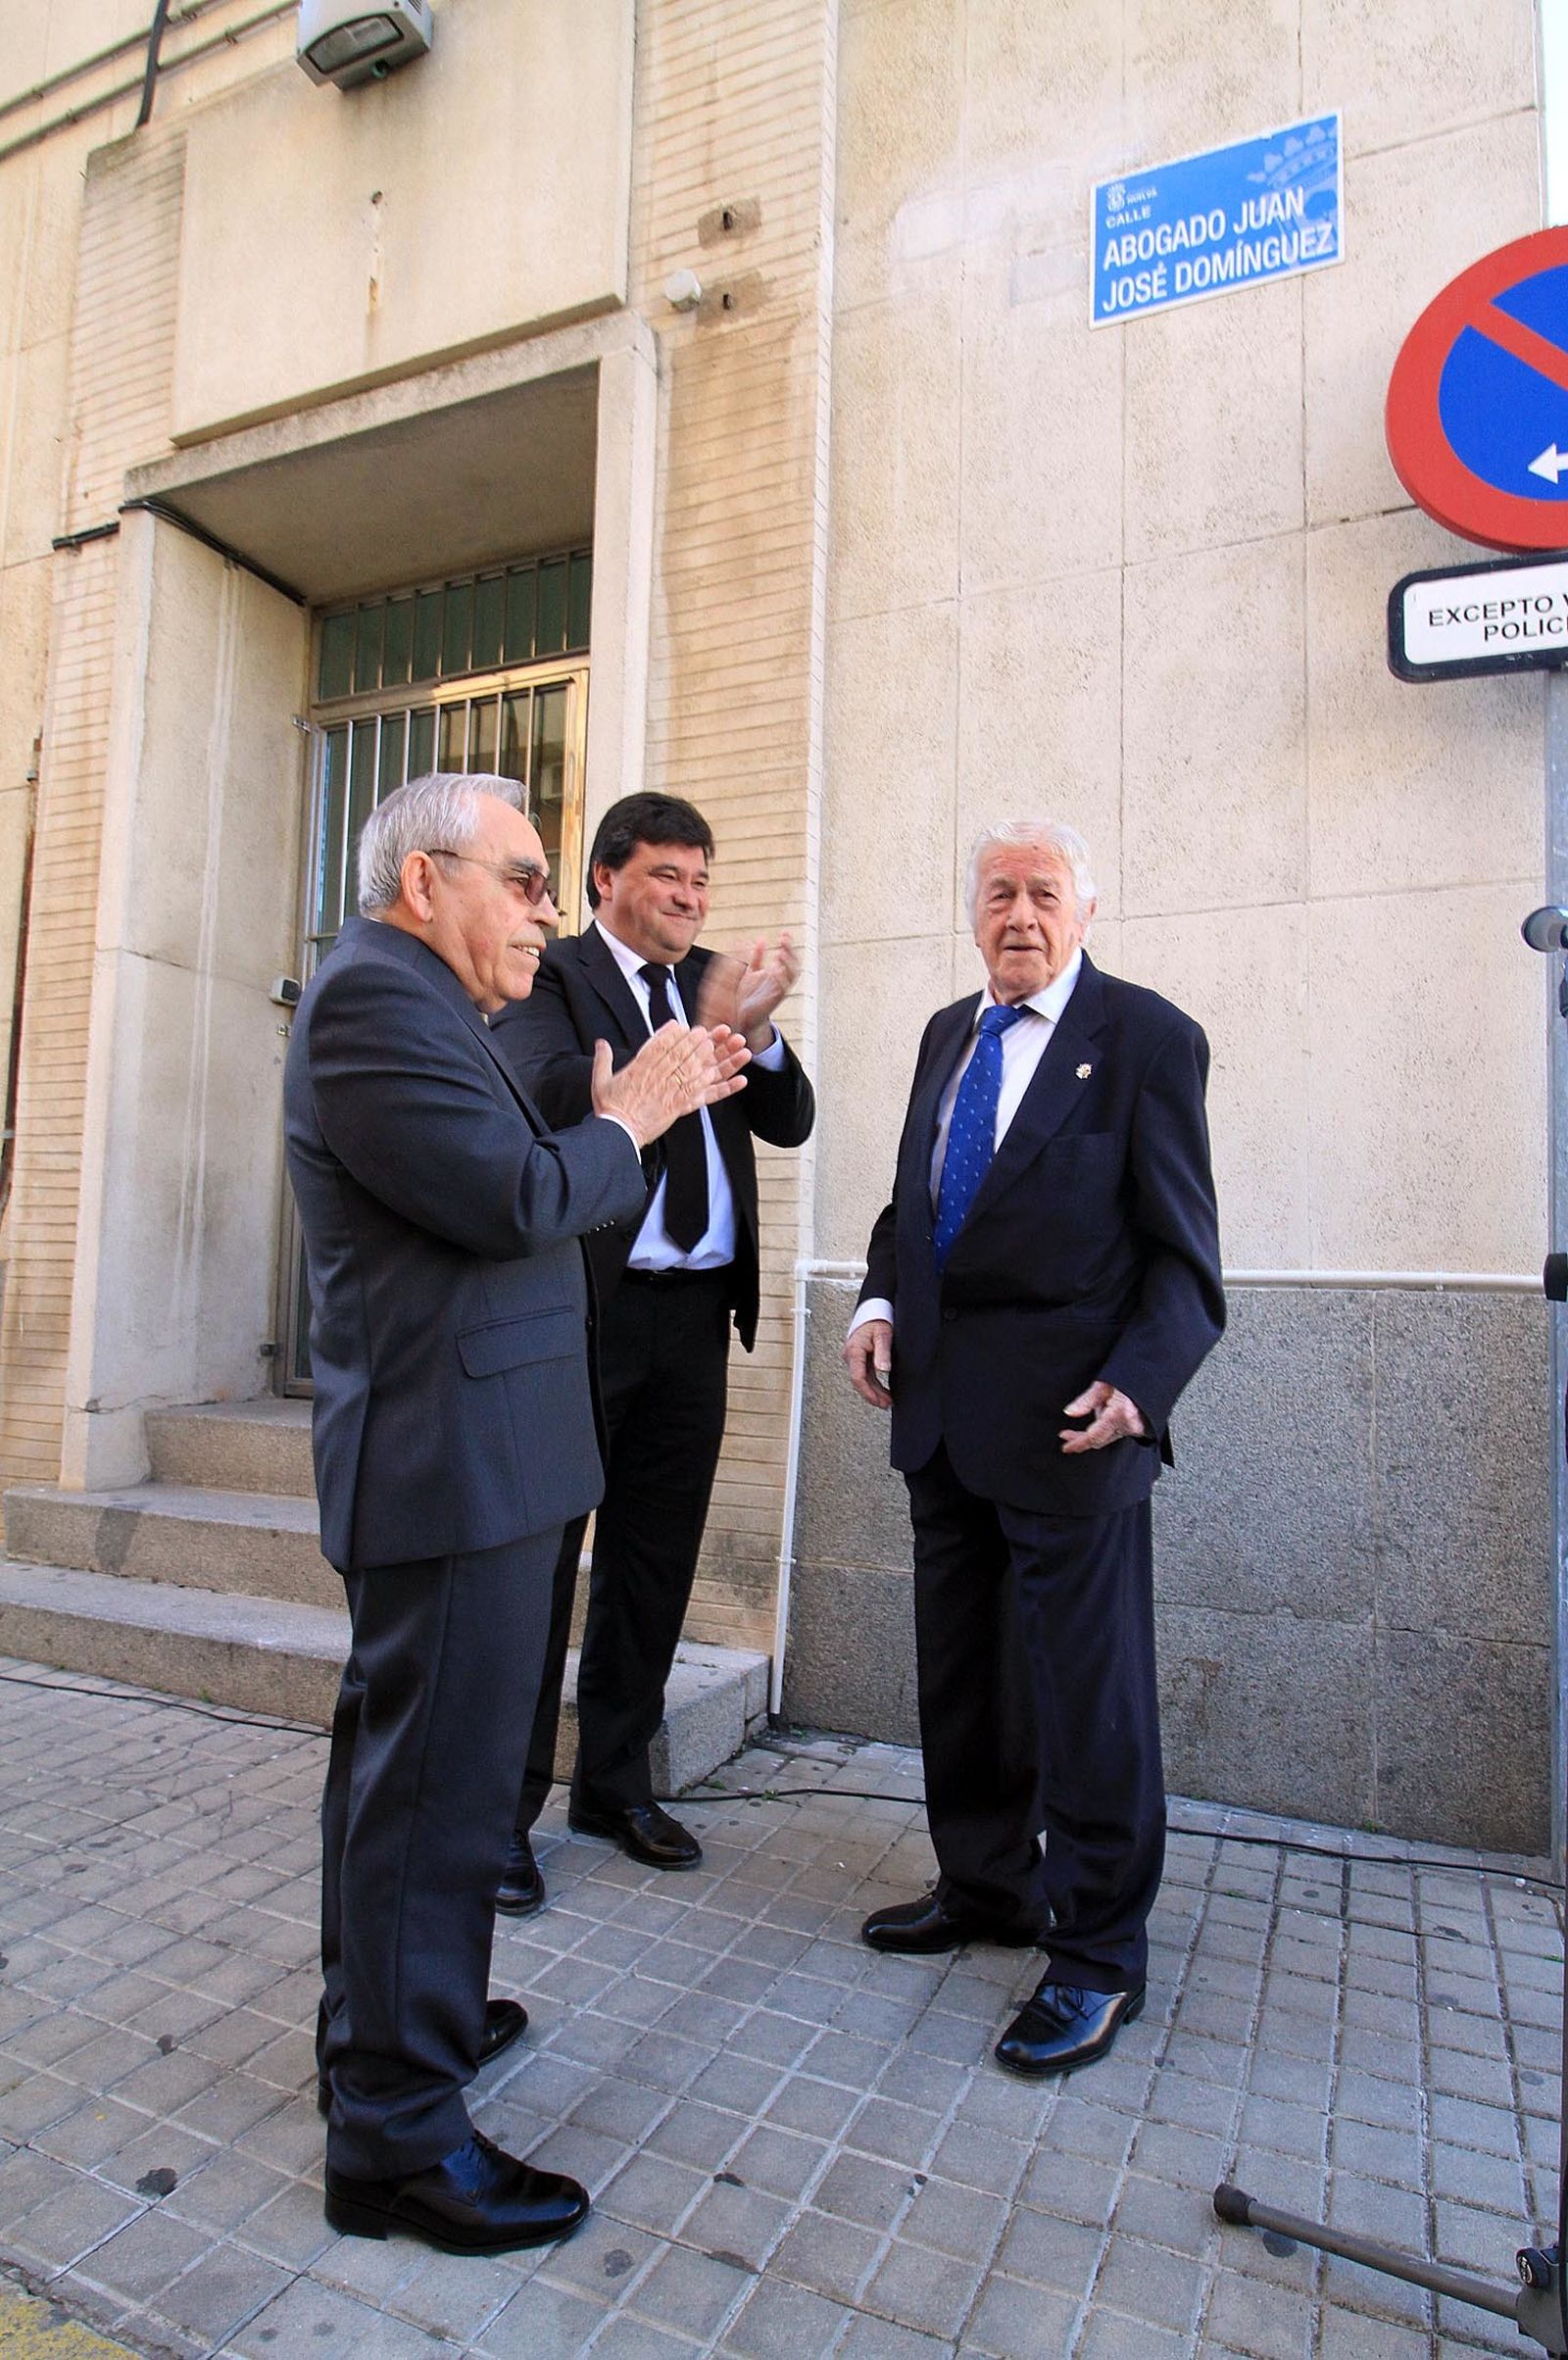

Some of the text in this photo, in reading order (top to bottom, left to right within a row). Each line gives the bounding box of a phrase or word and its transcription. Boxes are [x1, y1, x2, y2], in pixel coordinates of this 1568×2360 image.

[1103, 186, 1304, 270] ABOGADO JUAN
[1105, 204, 1152, 229] CALLE
[1102, 221, 1335, 313] JOSÉ DOMÍNGUEZ
[1429, 595, 1553, 627] EXCEPTO
